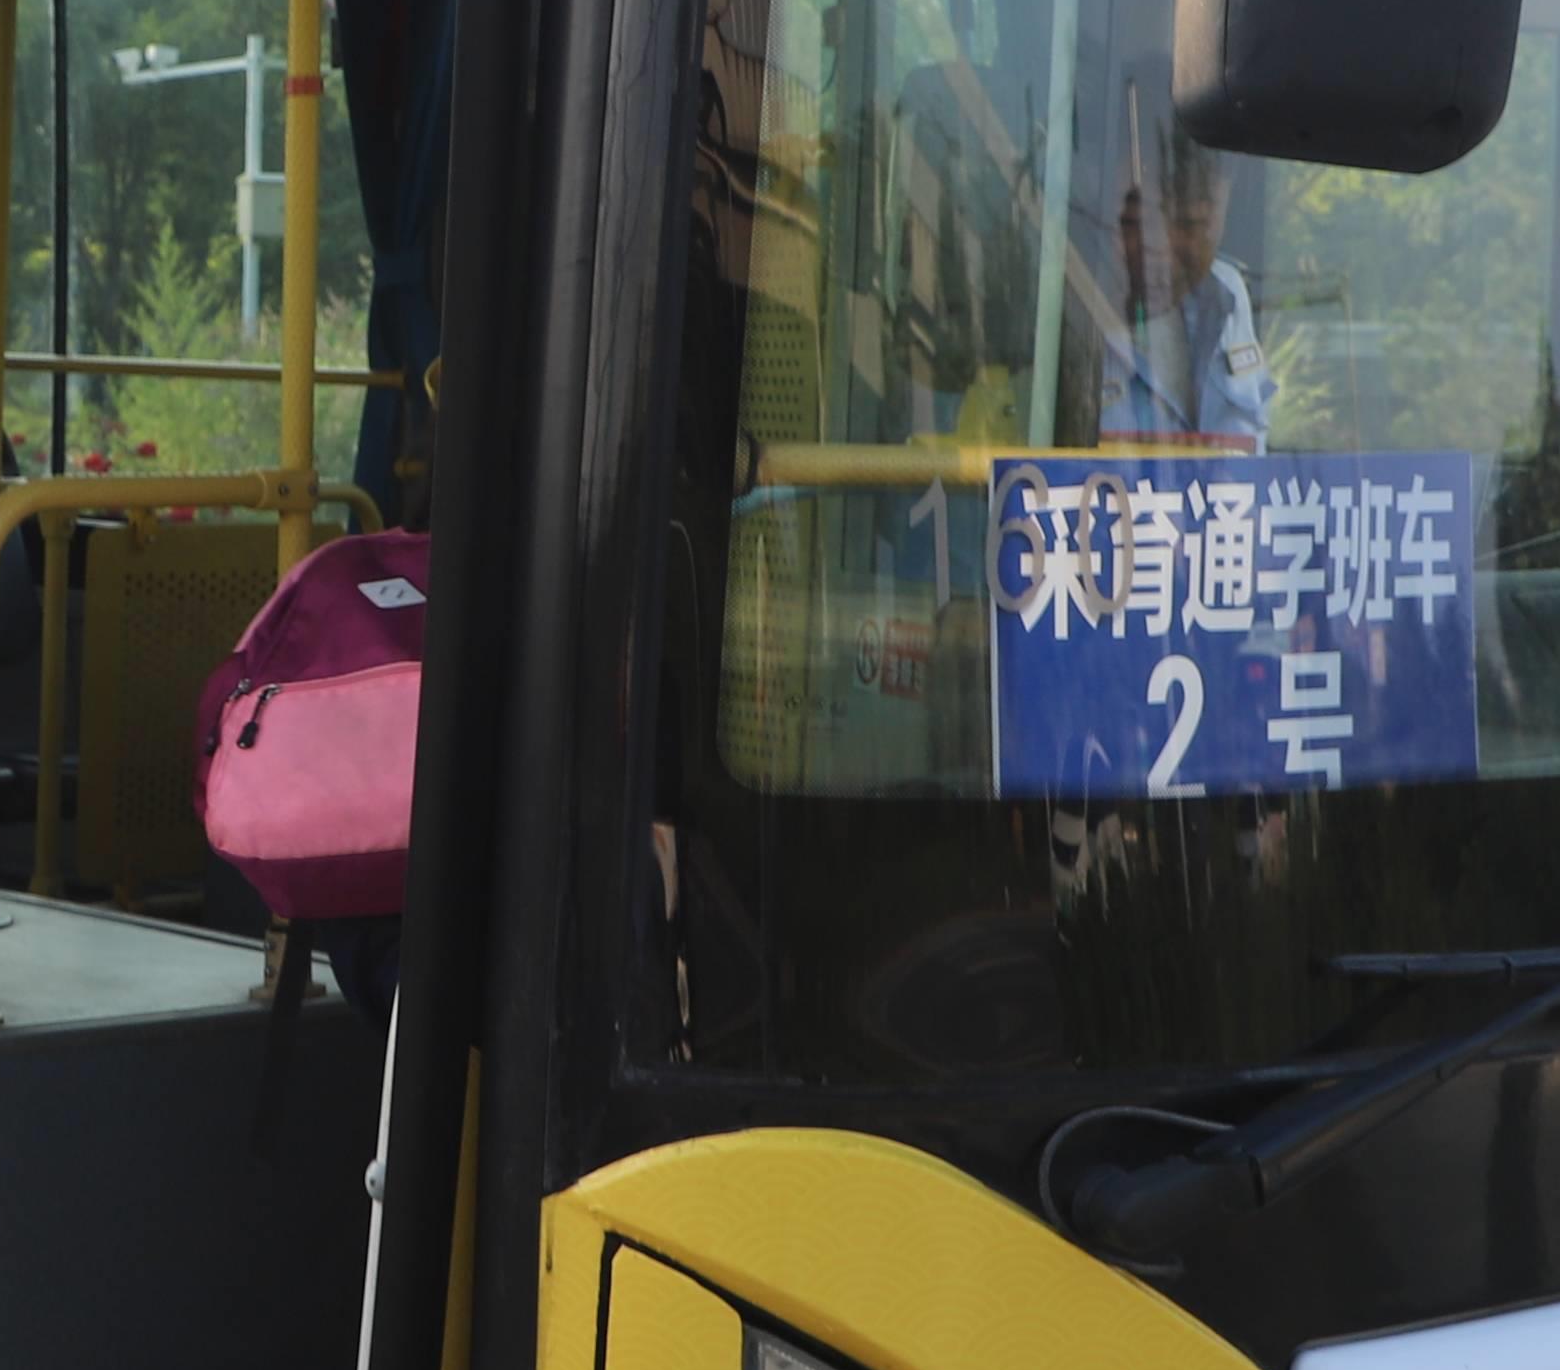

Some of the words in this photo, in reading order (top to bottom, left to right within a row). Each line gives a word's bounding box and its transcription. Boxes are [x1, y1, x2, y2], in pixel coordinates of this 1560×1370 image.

[1020, 474, 1457, 641] 采育通学班车
